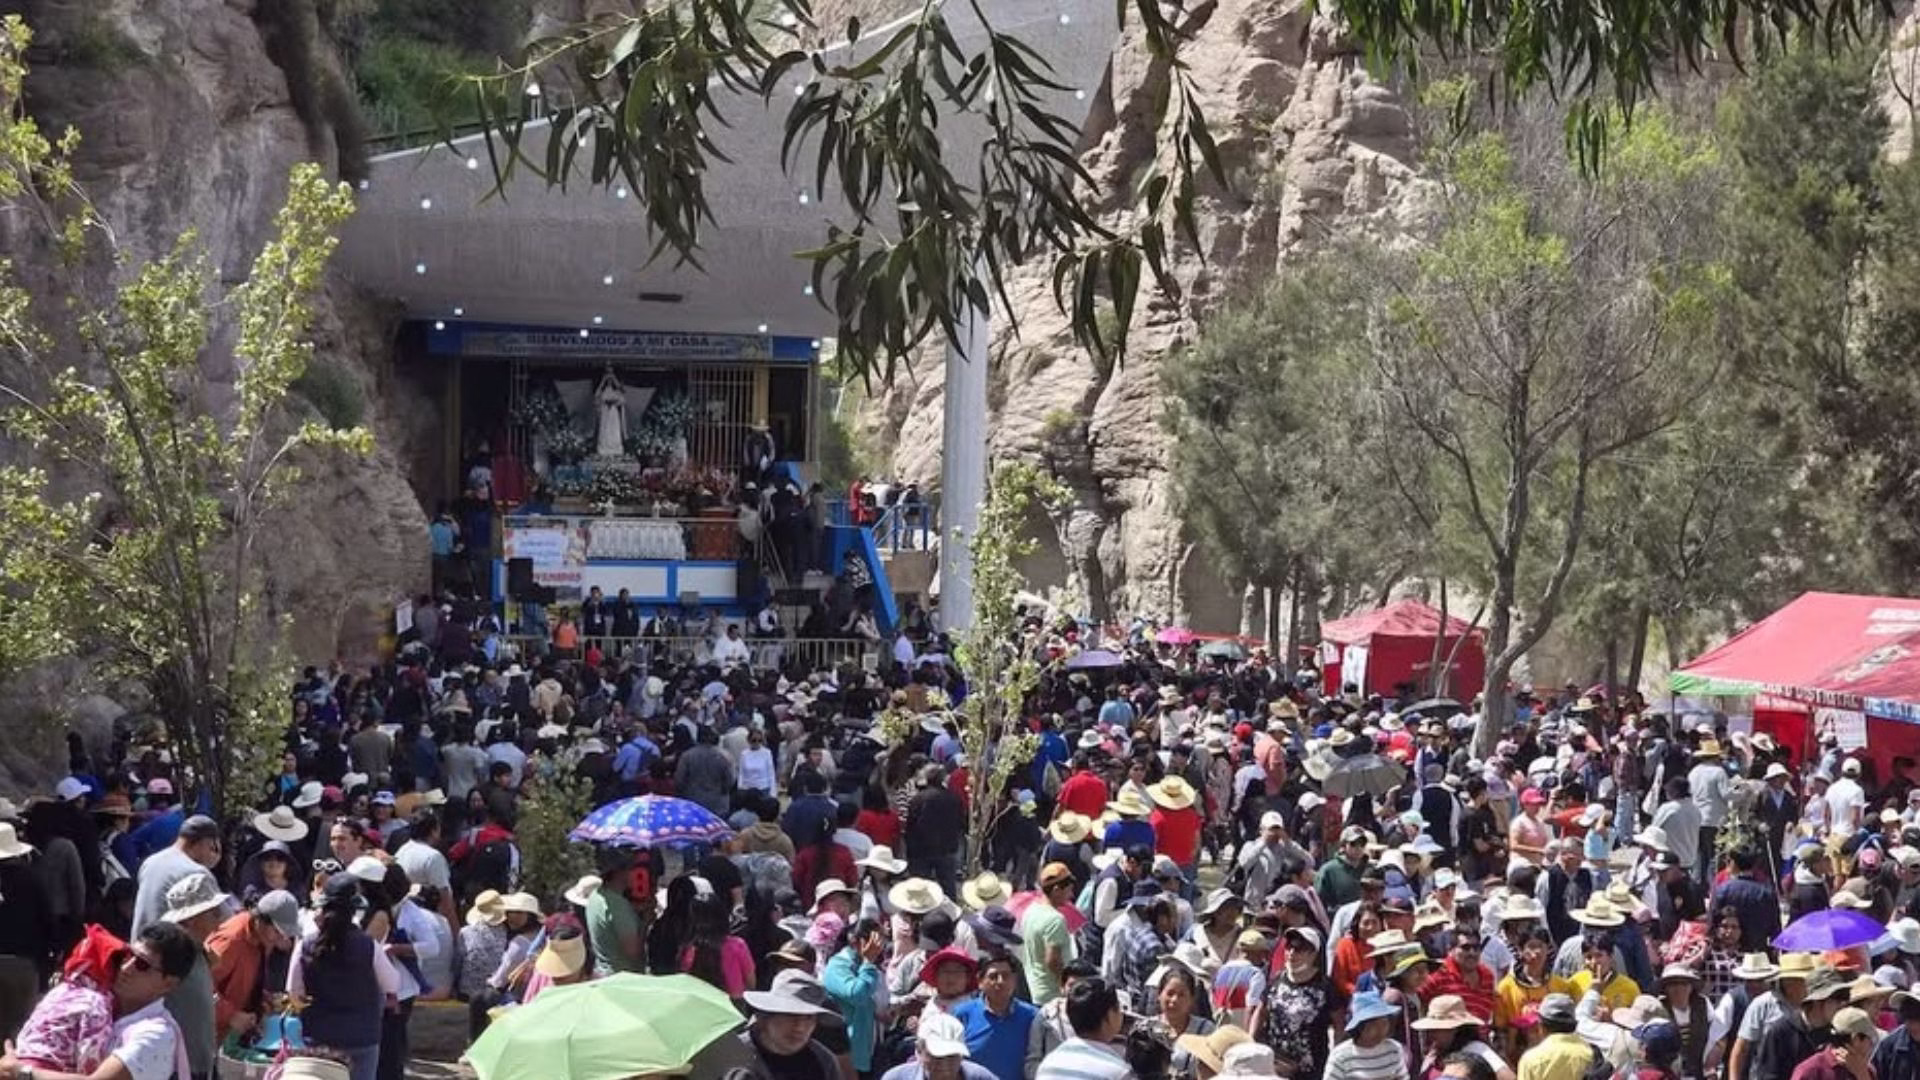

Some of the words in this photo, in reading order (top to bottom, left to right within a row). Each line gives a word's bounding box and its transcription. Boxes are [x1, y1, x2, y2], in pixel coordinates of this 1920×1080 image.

[526, 334, 628, 345] BIENVENIDOS
[631, 336, 642, 346] A
[646, 336, 664, 346] MI
[669, 337, 710, 347] CASA
